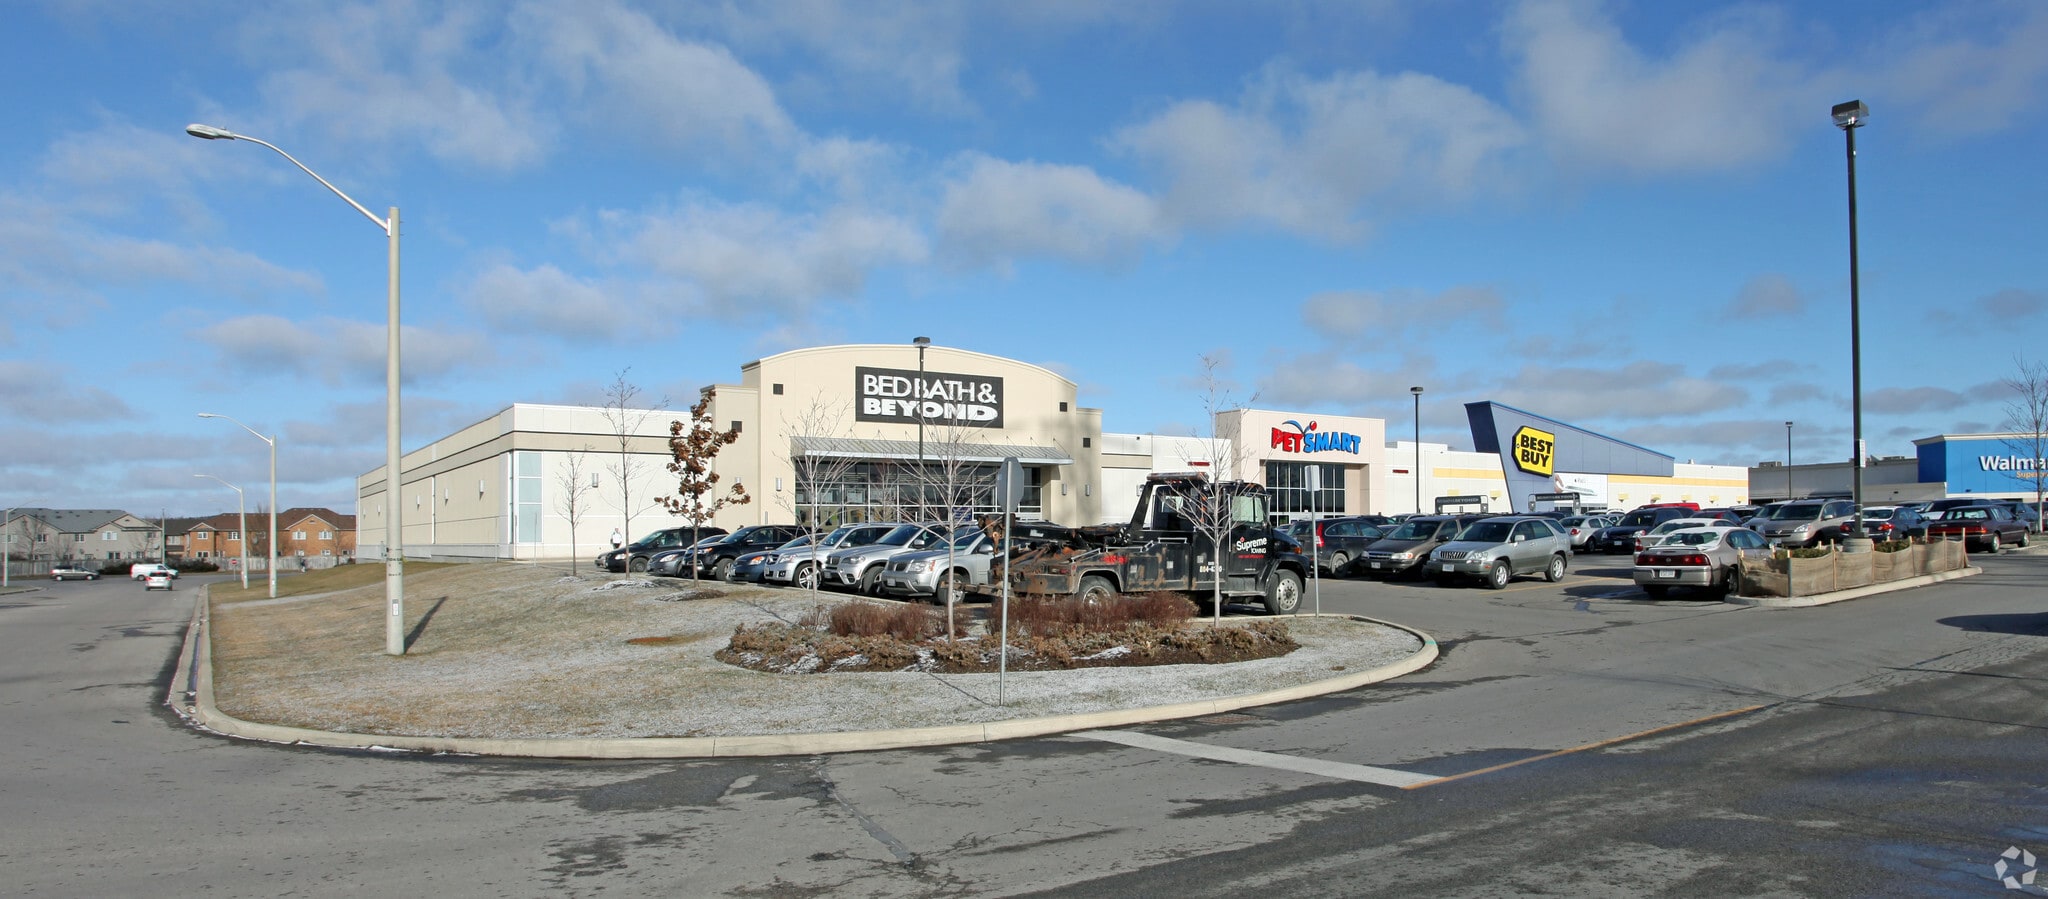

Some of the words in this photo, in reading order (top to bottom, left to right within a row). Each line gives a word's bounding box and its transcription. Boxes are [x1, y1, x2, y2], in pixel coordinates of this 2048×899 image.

[863, 374, 912, 397] BED
[914, 377, 976, 402] BATH
[977, 383, 998, 404] &
[863, 398, 998, 421] BEYOND
[1271, 427, 1361, 455] PETSMART
[1520, 434, 1553, 455] BEST
[1521, 448, 1550, 468] BUY
[1979, 455, 2048, 471] Walma
[1236, 537, 1267, 551] Supreme
